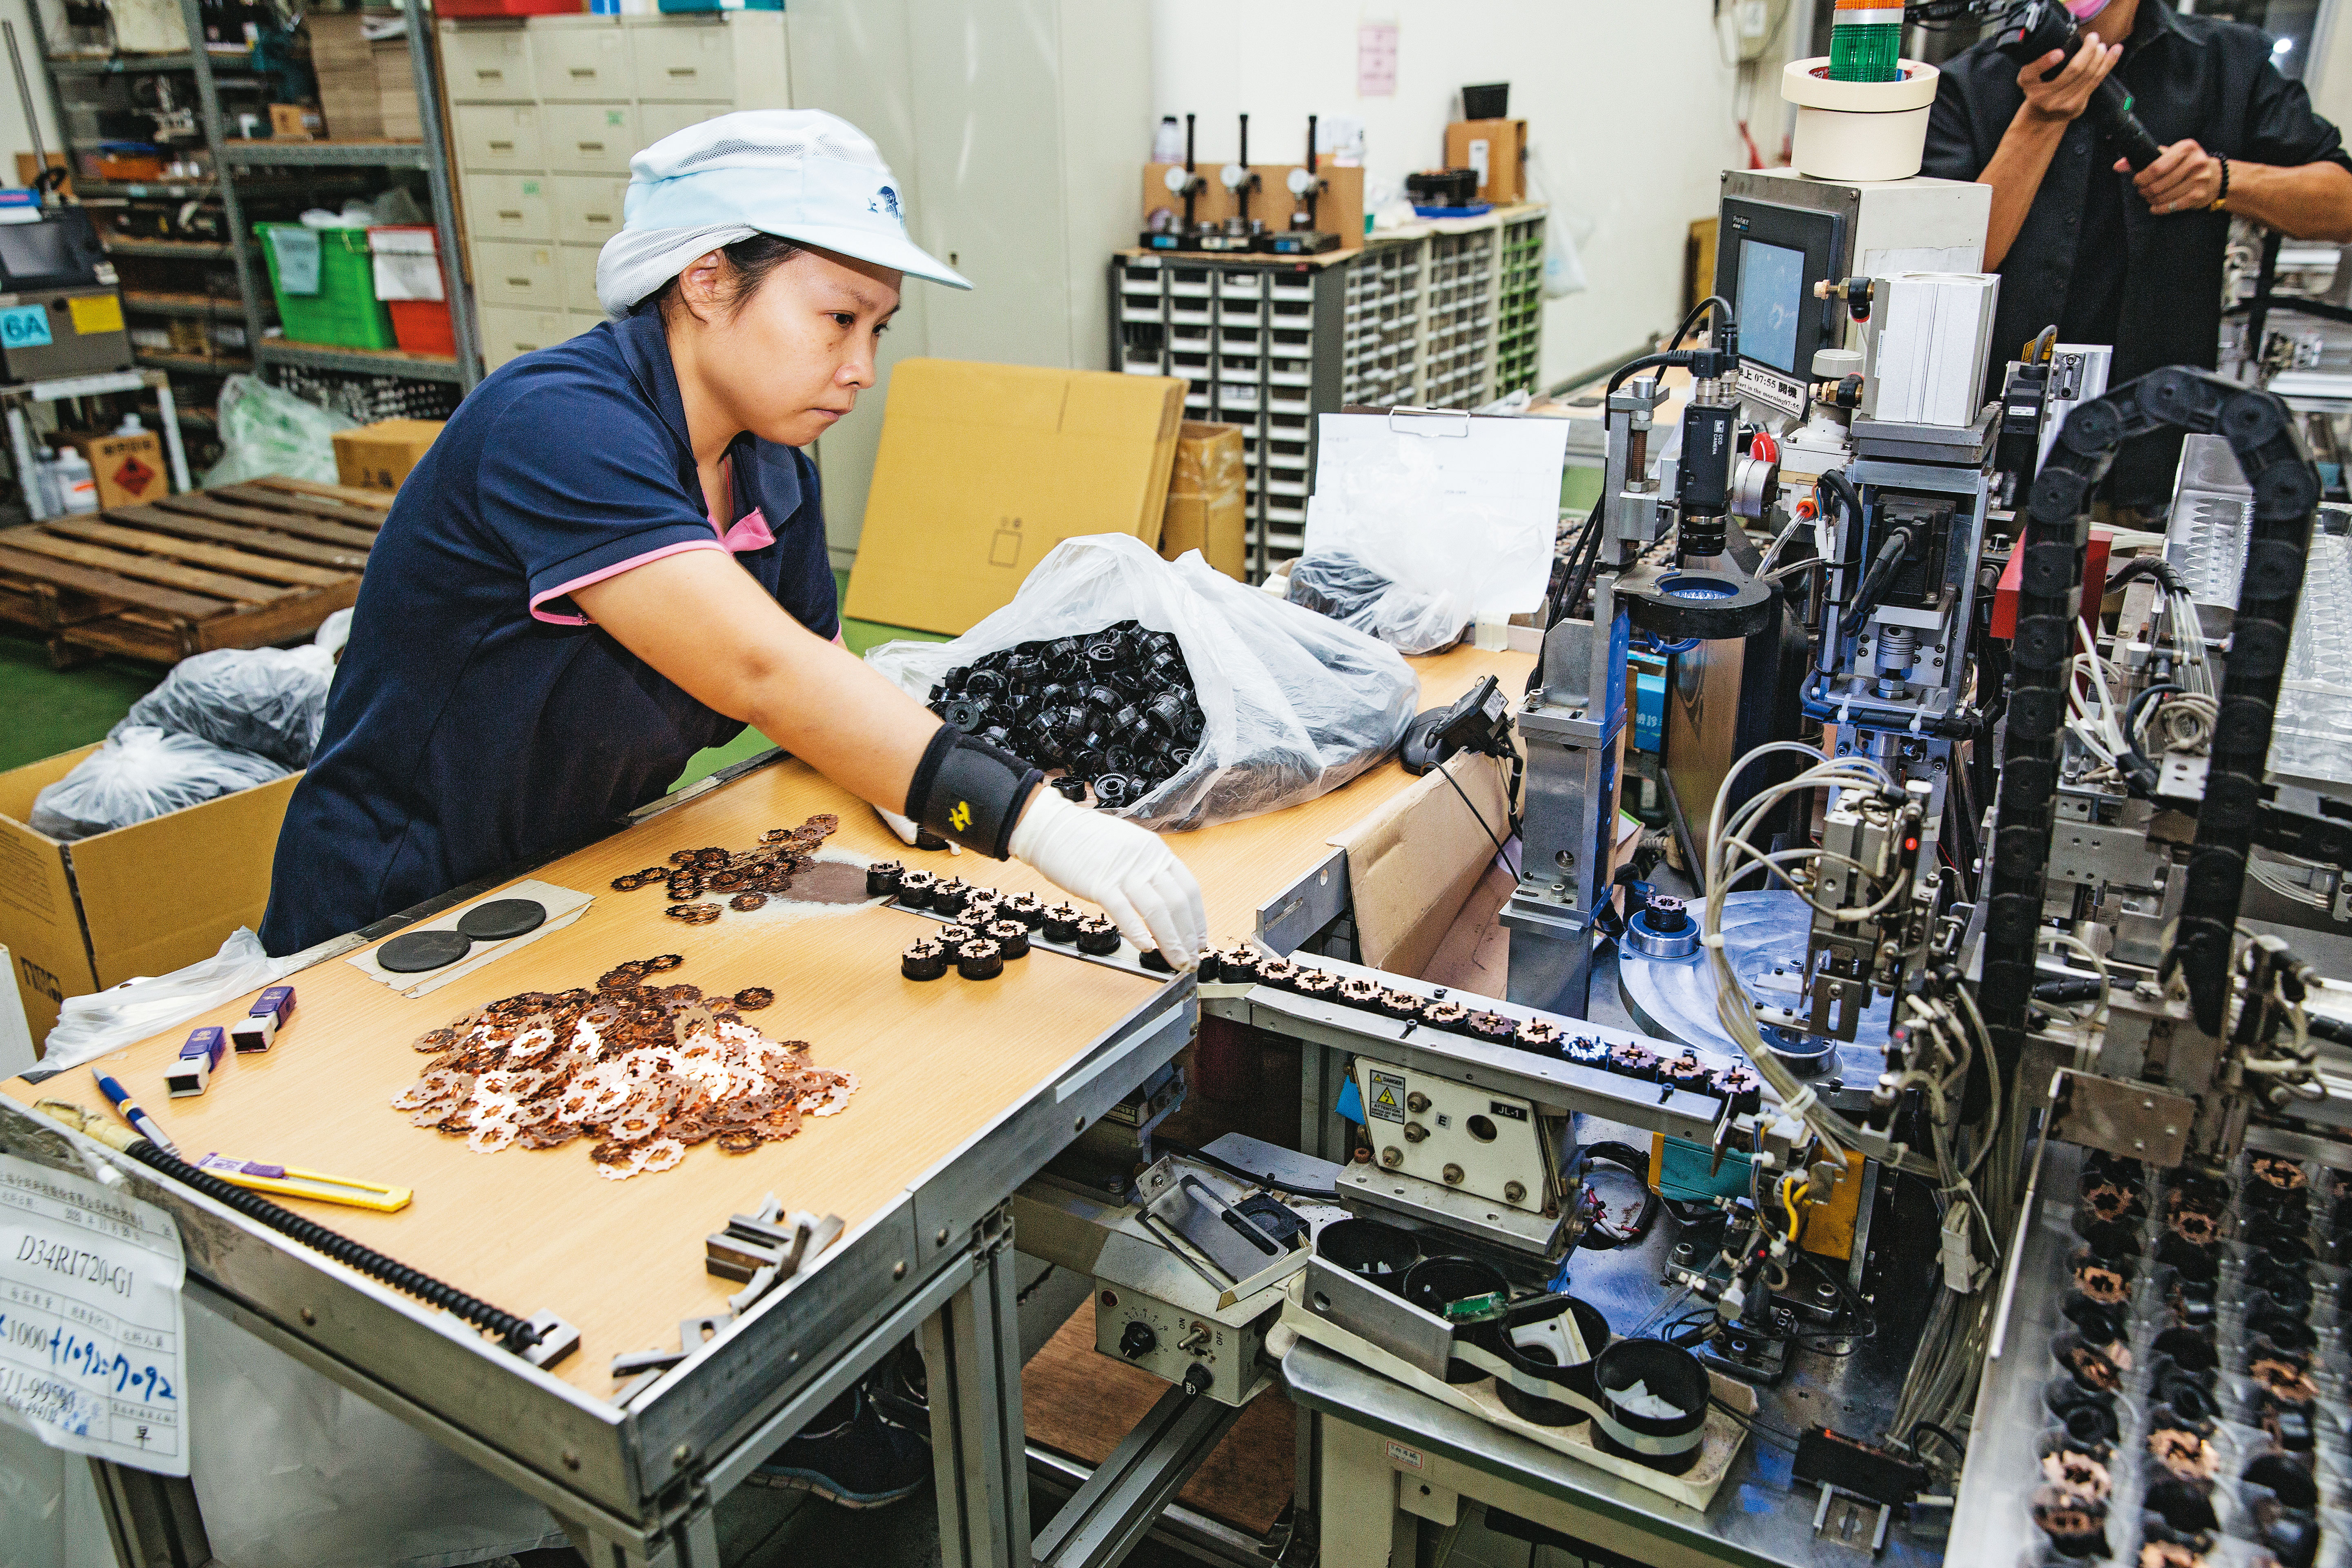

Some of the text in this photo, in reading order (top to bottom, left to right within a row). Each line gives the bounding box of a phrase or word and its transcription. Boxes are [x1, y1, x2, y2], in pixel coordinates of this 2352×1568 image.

[3, 313, 46, 341] 6A
[1754, 374, 1776, 388] 07:55
[1753, 386, 1762, 395] the
[1498, 1106, 1519, 1117] JL-1
[1438, 1115, 1447, 1126] E
[1179, 1317, 1185, 1329] ON
[136, 1425, 151, 1450] 早
